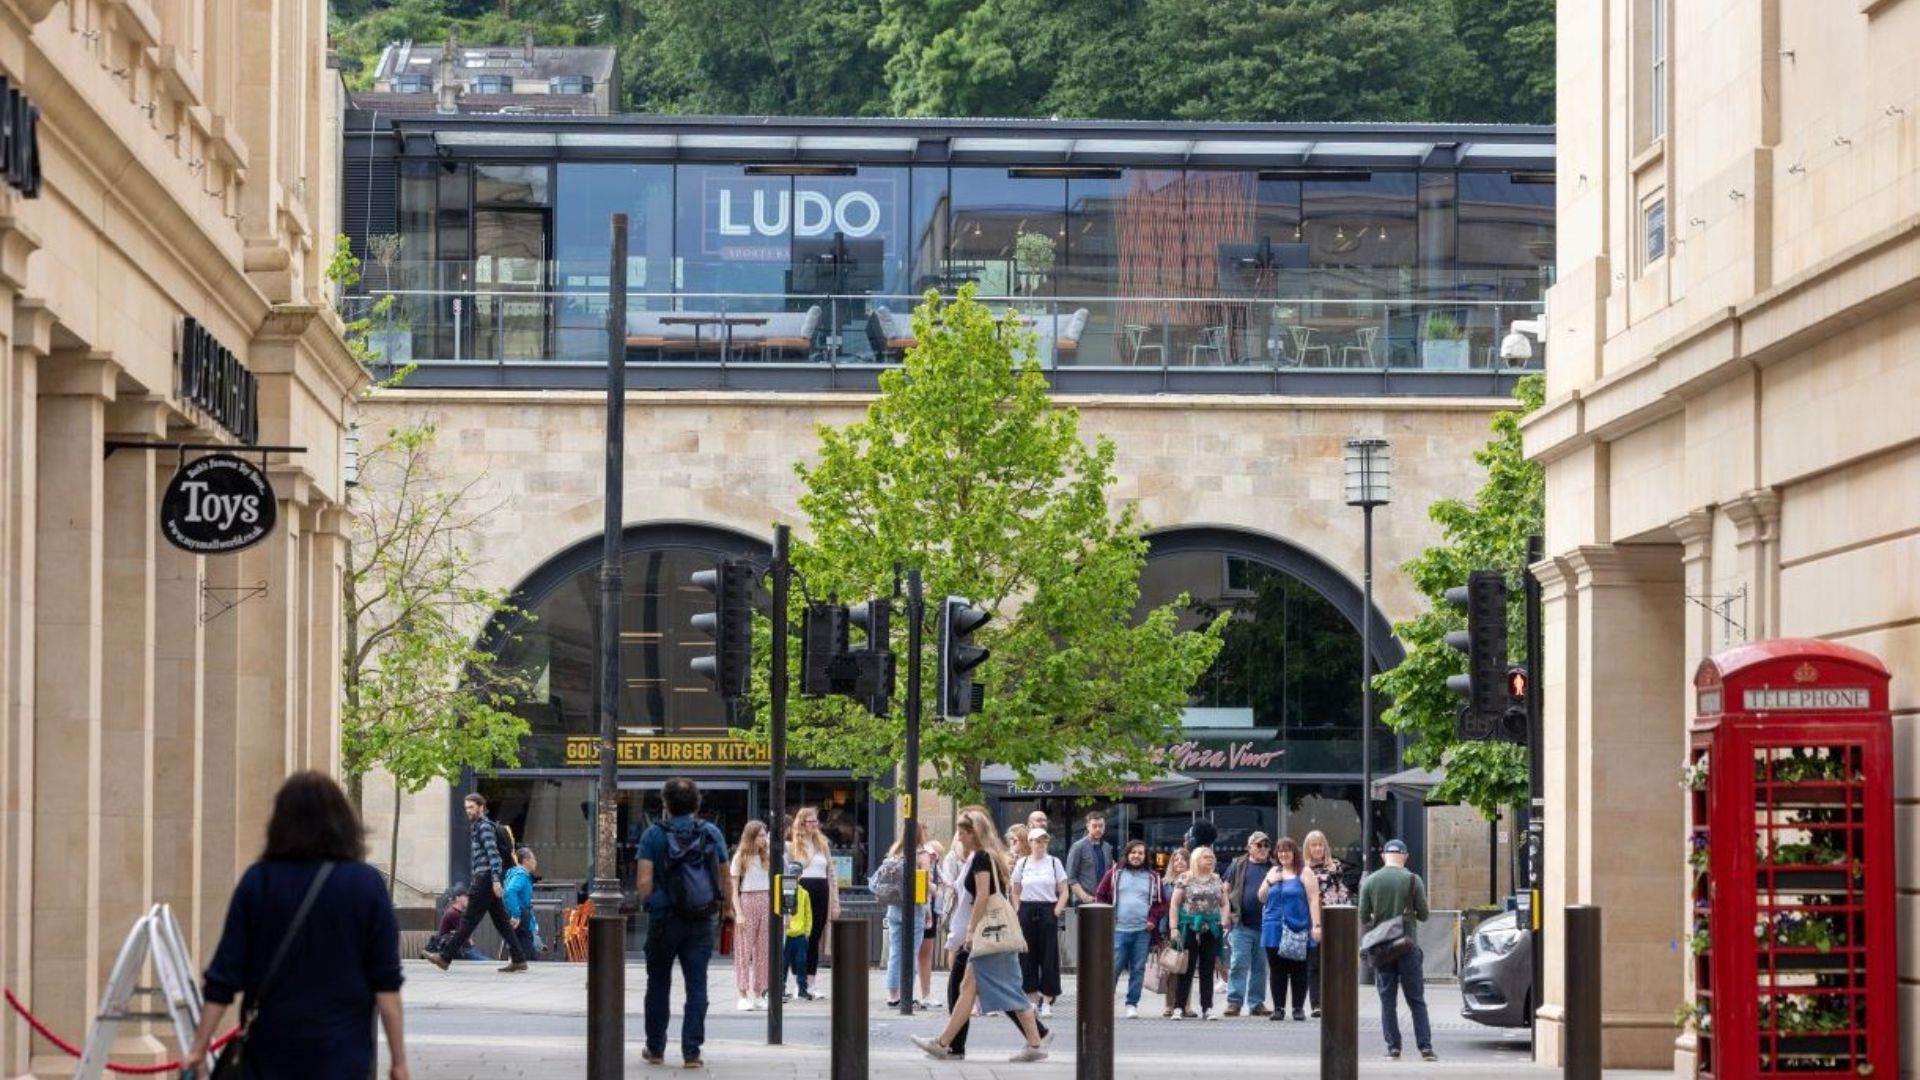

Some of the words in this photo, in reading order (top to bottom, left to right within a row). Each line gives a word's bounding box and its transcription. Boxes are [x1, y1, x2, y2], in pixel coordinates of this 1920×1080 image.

[720, 189, 880, 238] LUDO
[179, 481, 260, 531] Toys
[1751, 690, 1865, 707] TELEPHONE
[566, 742, 644, 760] GOUMET
[649, 742, 712, 760] BURGER
[1229, 741, 1286, 770] Vino
